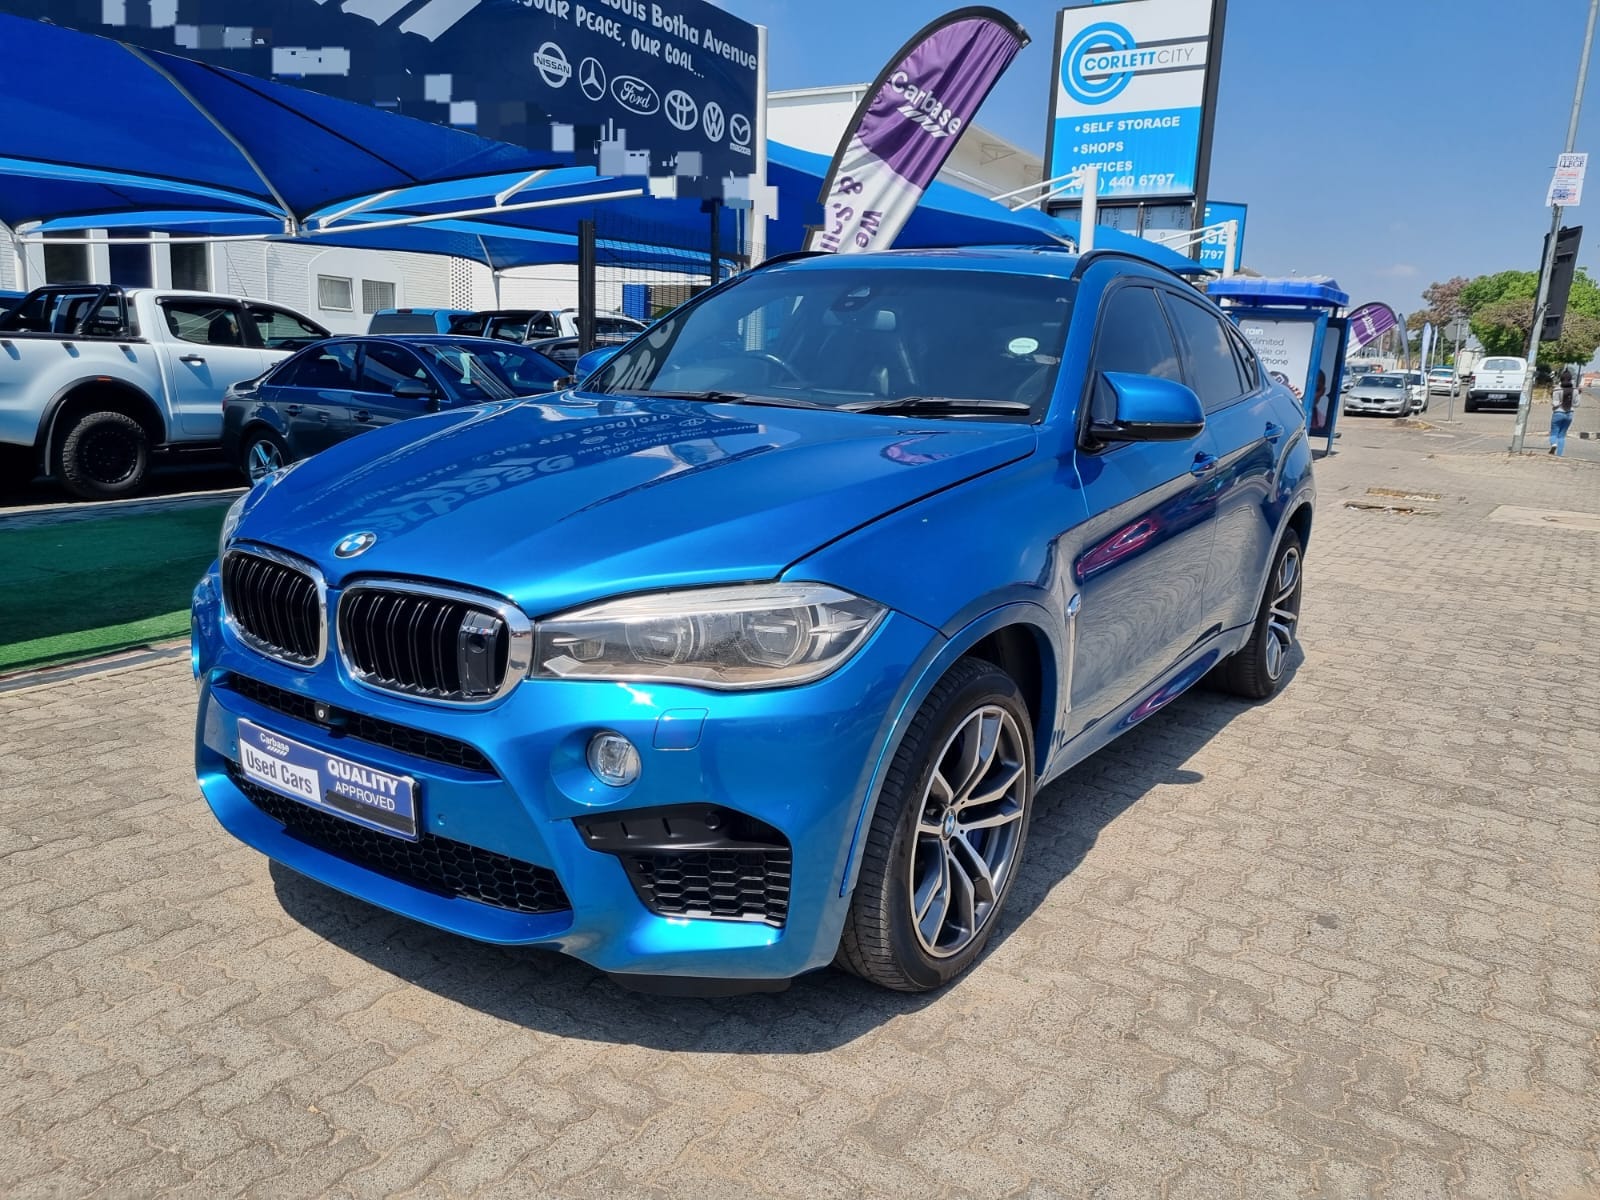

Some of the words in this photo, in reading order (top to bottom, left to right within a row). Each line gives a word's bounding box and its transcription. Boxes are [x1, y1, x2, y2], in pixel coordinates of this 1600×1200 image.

[631, 28, 660, 57] OUR
[652, 3, 699, 45] Botha
[703, 29, 758, 70] Avenue
[536, 55, 570, 74] NISSAN
[1084, 51, 1157, 71] CORLETT
[620, 80, 652, 108] Ford
[889, 71, 963, 136] Carbase
[1082, 121, 1114, 134] SELF
[1117, 116, 1181, 131] STORAGE
[1080, 141, 1124, 154] SHOPS
[1079, 160, 1133, 173] OFICES
[838, 176, 863, 195] &
[1108, 175, 1135, 187] 440
[1139, 173, 1175, 186] 6797
[856, 210, 883, 249] We
[1245, 327, 1264, 335] rain
[1250, 337, 1285, 346] nlimited
[259, 733, 290, 752] Carbase
[246, 751, 277, 780] Used
[281, 765, 313, 795] Cars
[327, 759, 398, 796] QUALITY
[335, 781, 396, 812] APPROVED
